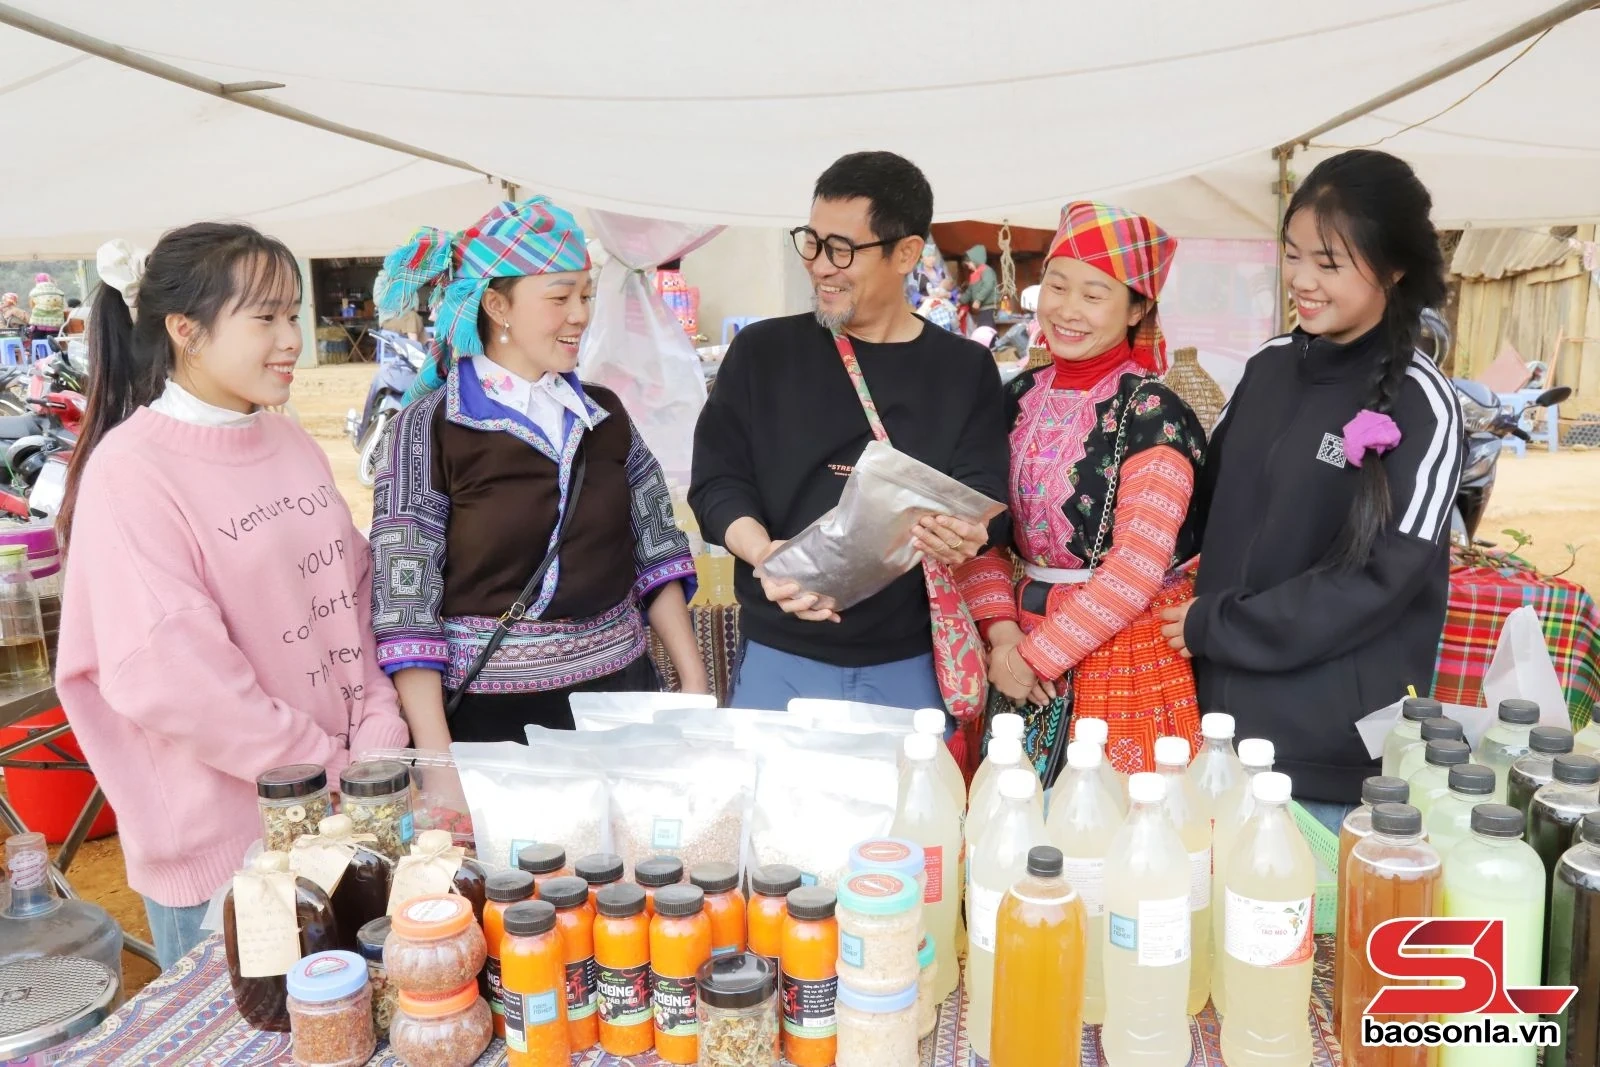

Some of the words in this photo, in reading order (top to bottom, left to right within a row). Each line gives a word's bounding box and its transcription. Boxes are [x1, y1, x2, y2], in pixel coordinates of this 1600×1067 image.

[218, 497, 295, 541] Venture
[298, 484, 338, 516] OUT
[297, 539, 345, 579] YOUR
